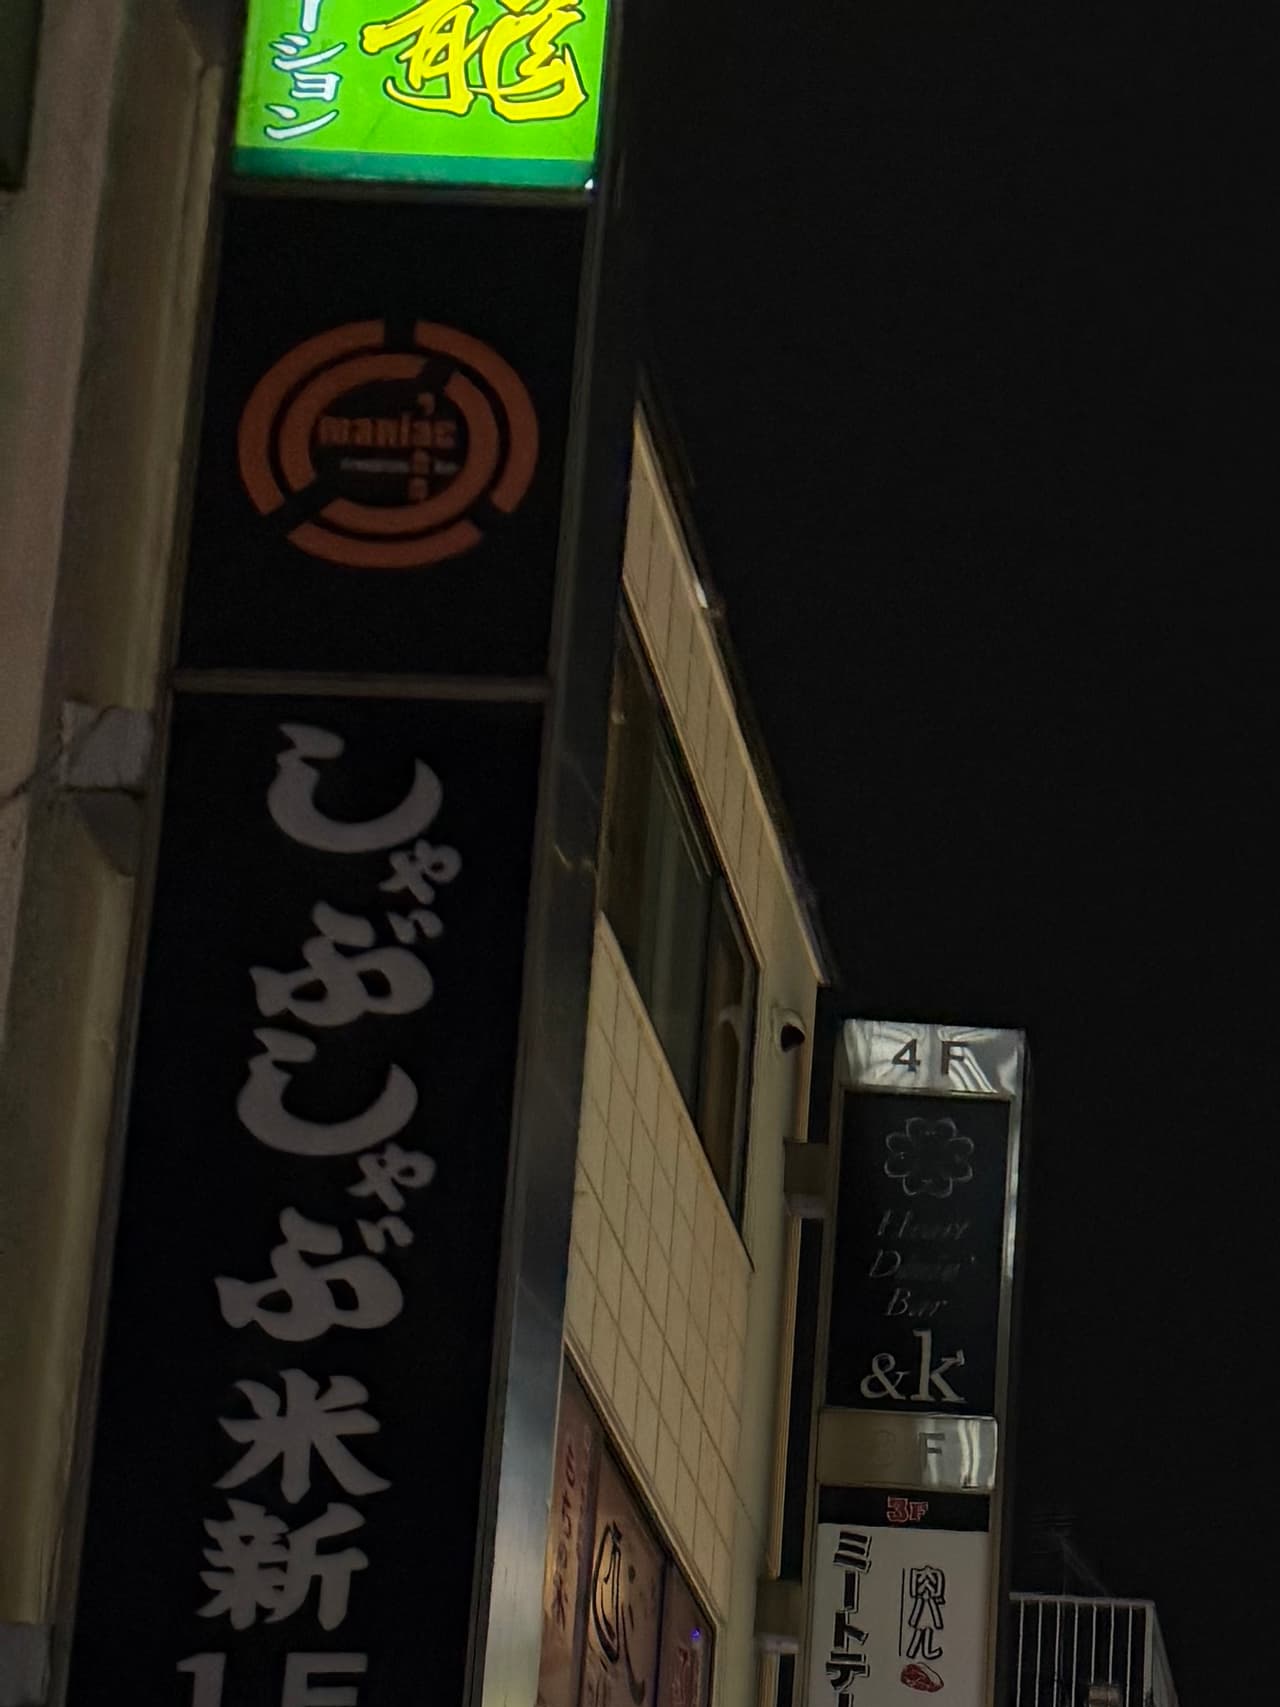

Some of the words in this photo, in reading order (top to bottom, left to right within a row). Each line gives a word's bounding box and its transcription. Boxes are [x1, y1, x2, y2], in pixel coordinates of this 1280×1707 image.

[887, 1496, 929, 1523] 3F
[907, 1566, 946, 1660] 肉バル
